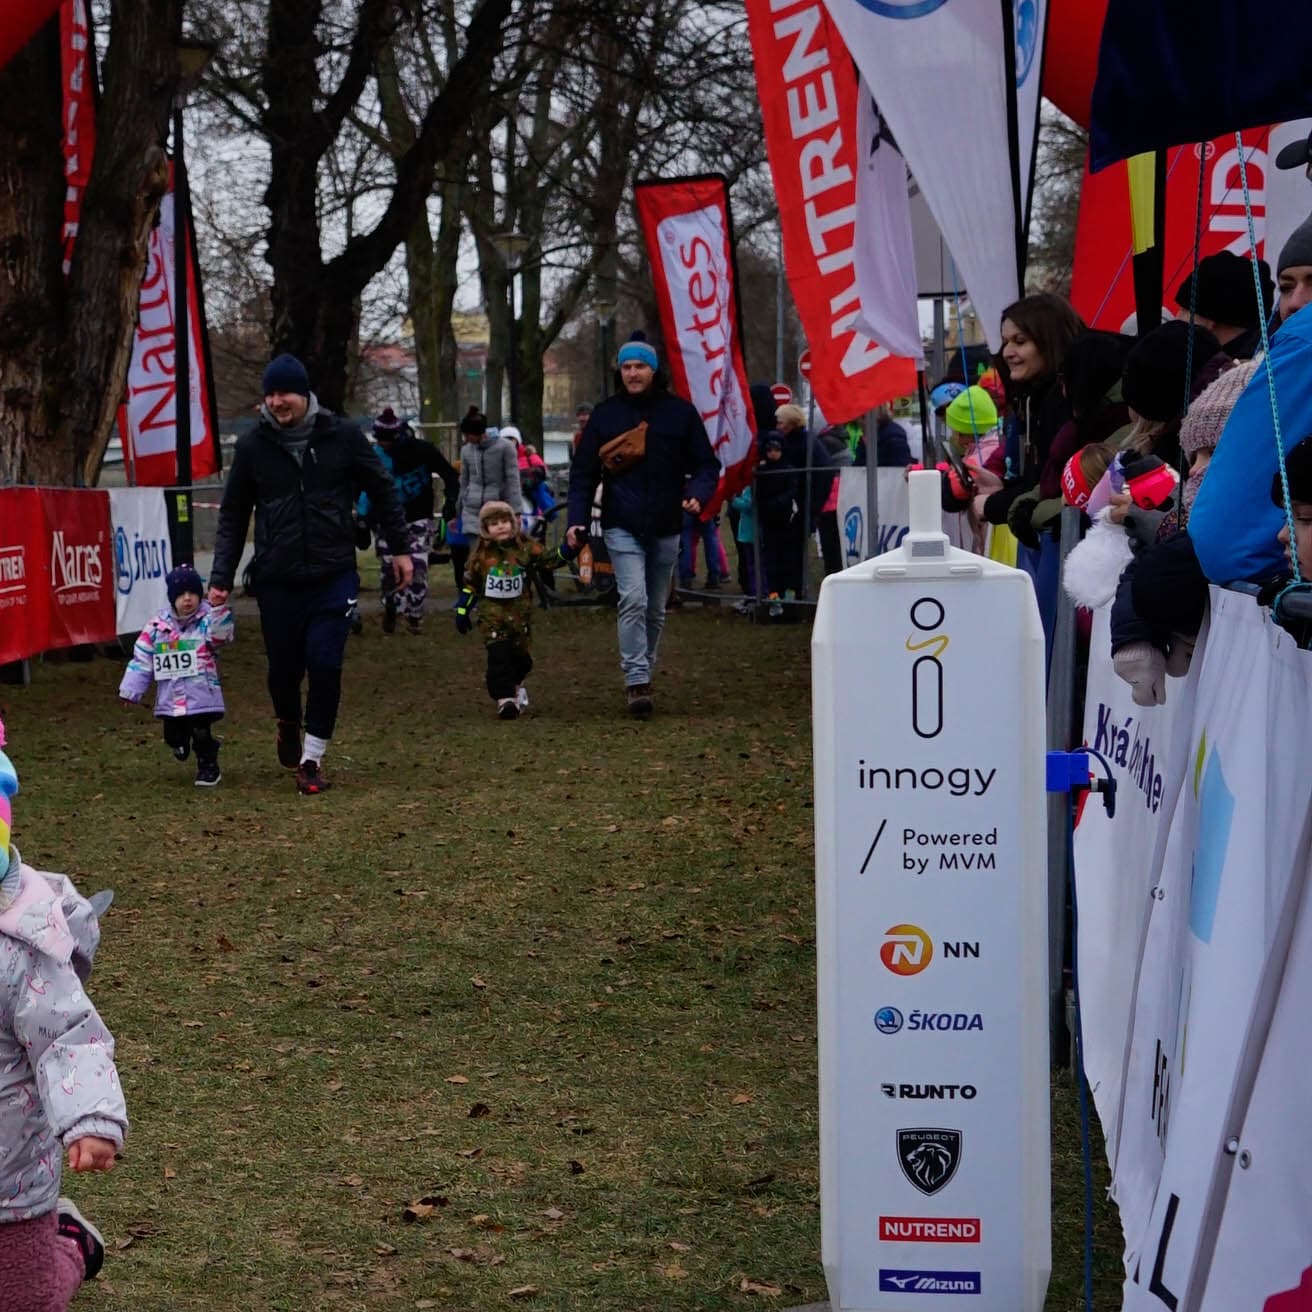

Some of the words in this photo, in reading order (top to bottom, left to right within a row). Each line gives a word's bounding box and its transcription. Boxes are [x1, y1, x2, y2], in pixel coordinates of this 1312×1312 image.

[487, 576, 521, 592] 3430
[154, 652, 192, 672] 3419
[859, 759, 996, 796] innogy
[903, 827, 997, 846] Powered
[903, 852, 929, 875] by
[939, 853, 996, 870] MVM
[943, 942, 980, 958] NN
[907, 1010, 984, 1031] ŠKODA
[899, 1084, 978, 1099] RUNTO
[885, 1222, 976, 1237] NUTREND
